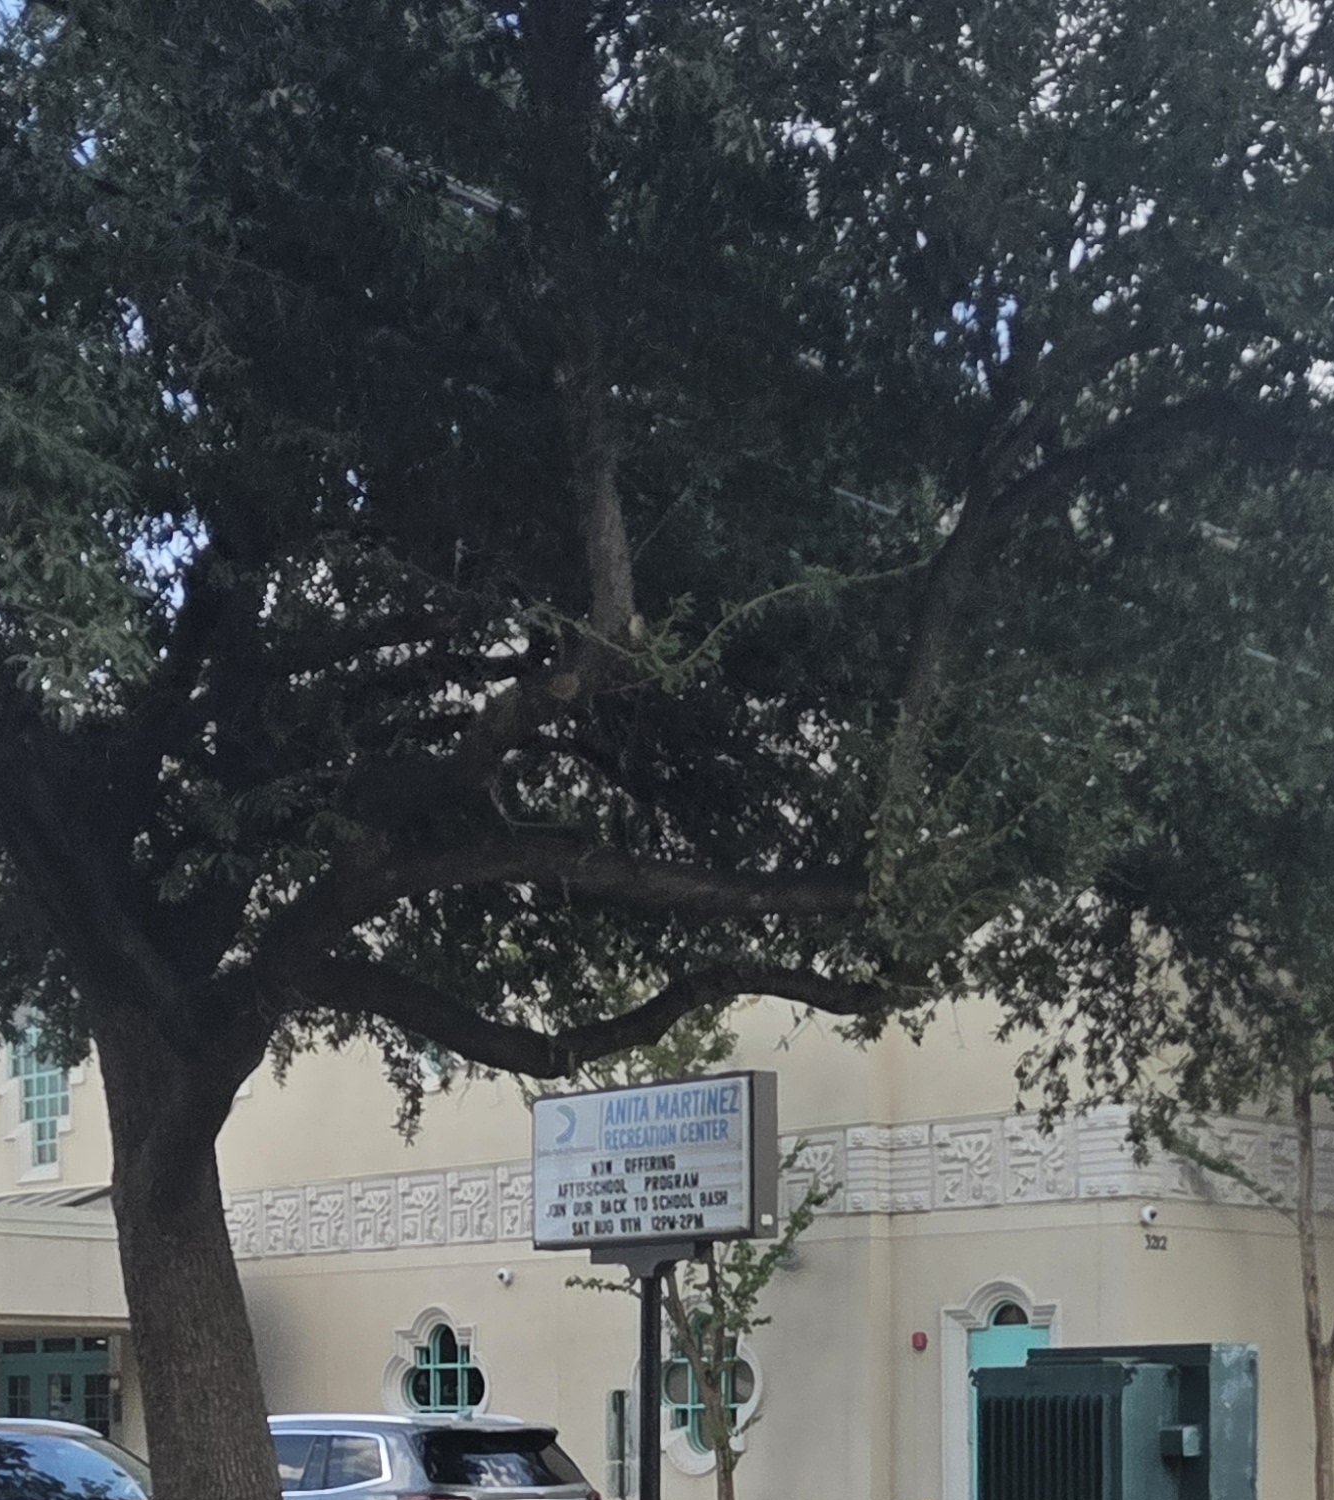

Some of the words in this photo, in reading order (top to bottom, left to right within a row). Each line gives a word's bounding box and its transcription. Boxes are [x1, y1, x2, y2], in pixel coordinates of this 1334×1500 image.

[604, 1096, 650, 1125] ANITA
[655, 1085, 740, 1120] MARTINEZ
[604, 1124, 676, 1150] RECREATION
[680, 1118, 729, 1143] CENTER
[590, 1160, 613, 1177] NOW
[625, 1155, 675, 1173] OFFERING
[644, 1172, 699, 1191] PROGRAM
[546, 1203, 567, 1218] JOIN
[572, 1200, 594, 1217] OUR
[600, 1198, 627, 1214] BACK
[634, 1196, 648, 1212] TO
[651, 1192, 695, 1211] SCHOOL
[700, 1190, 728, 1207] BASH
[572, 1220, 590, 1237] SAT
[594, 1218, 615, 1235] AUG
[620, 1216, 642, 1233] 8TH
[651, 1213, 704, 1231] 12PM-2PM
